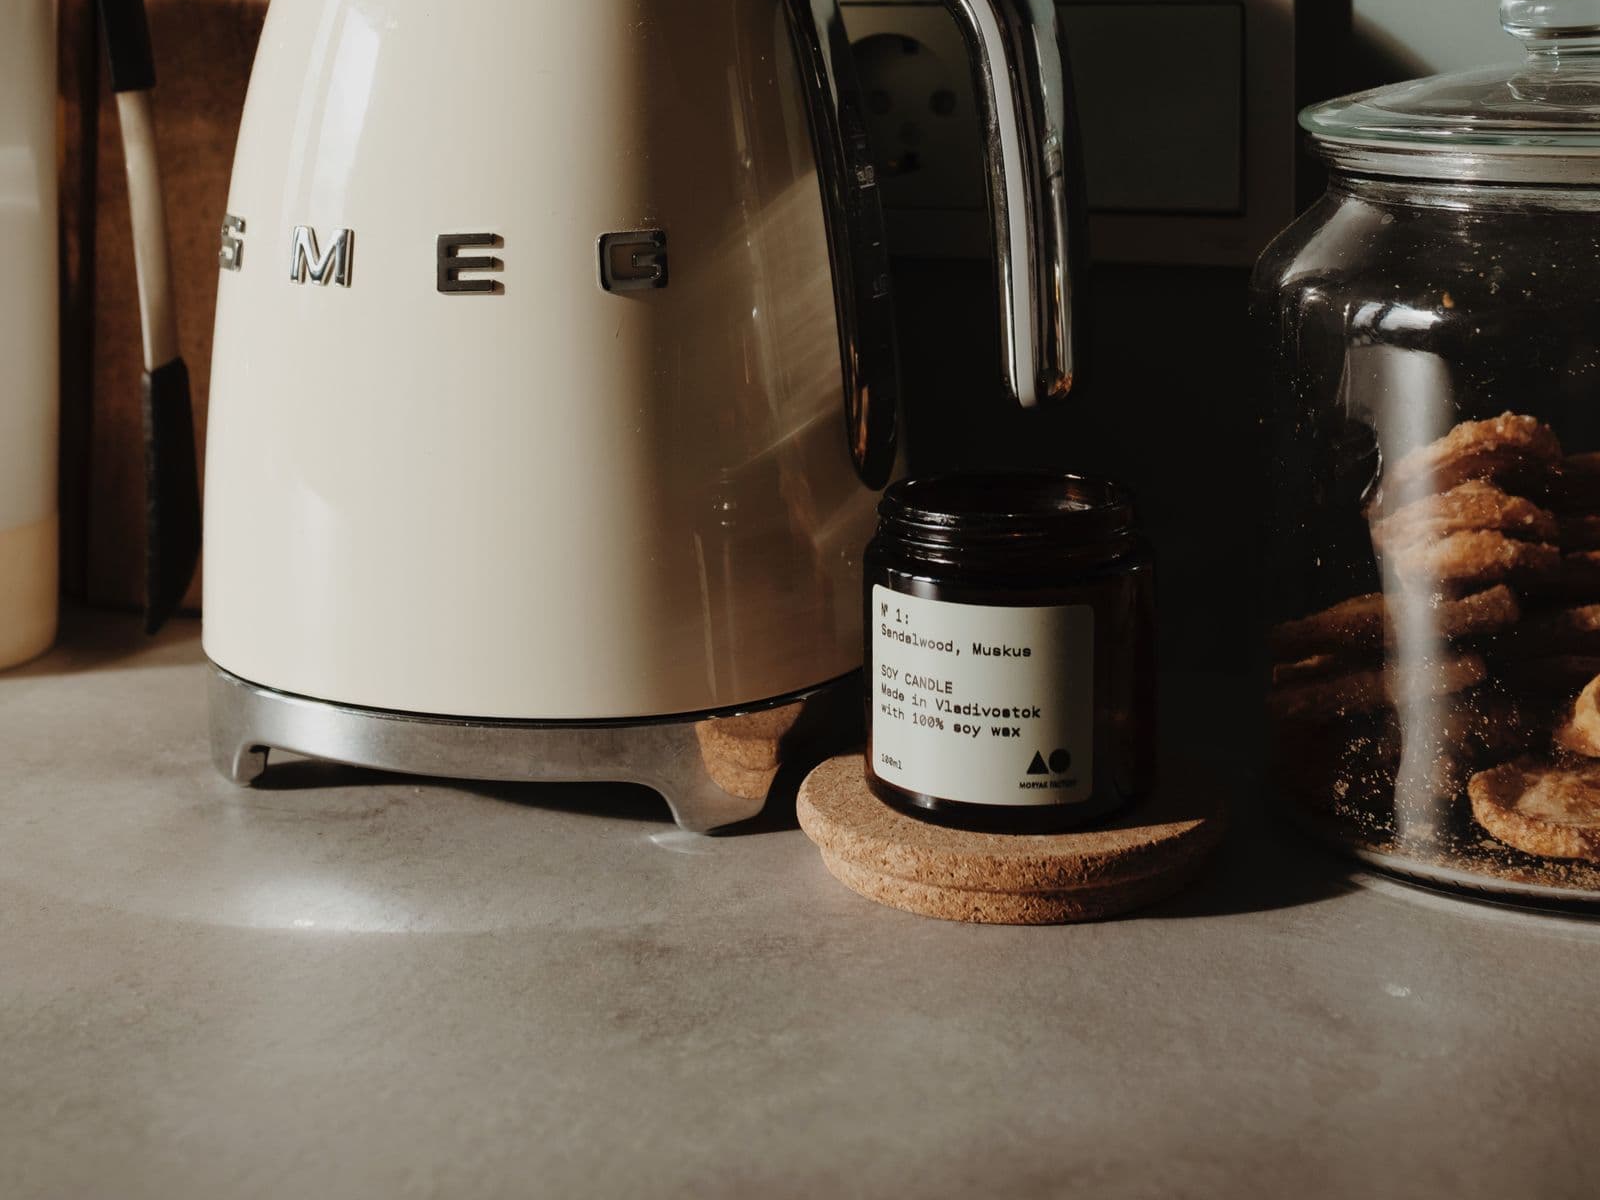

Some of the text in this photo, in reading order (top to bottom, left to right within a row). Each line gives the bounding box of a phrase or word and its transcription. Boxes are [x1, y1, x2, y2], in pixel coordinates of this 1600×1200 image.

[896, 608, 909, 625] 1:
[881, 624, 1032, 658] Sandalwood, Muskus
[881, 664, 954, 694] SOY CANDLE
[881, 683, 1041, 719] Made in Vladivostok
[881, 702, 1021, 738] with 100% soy wax
